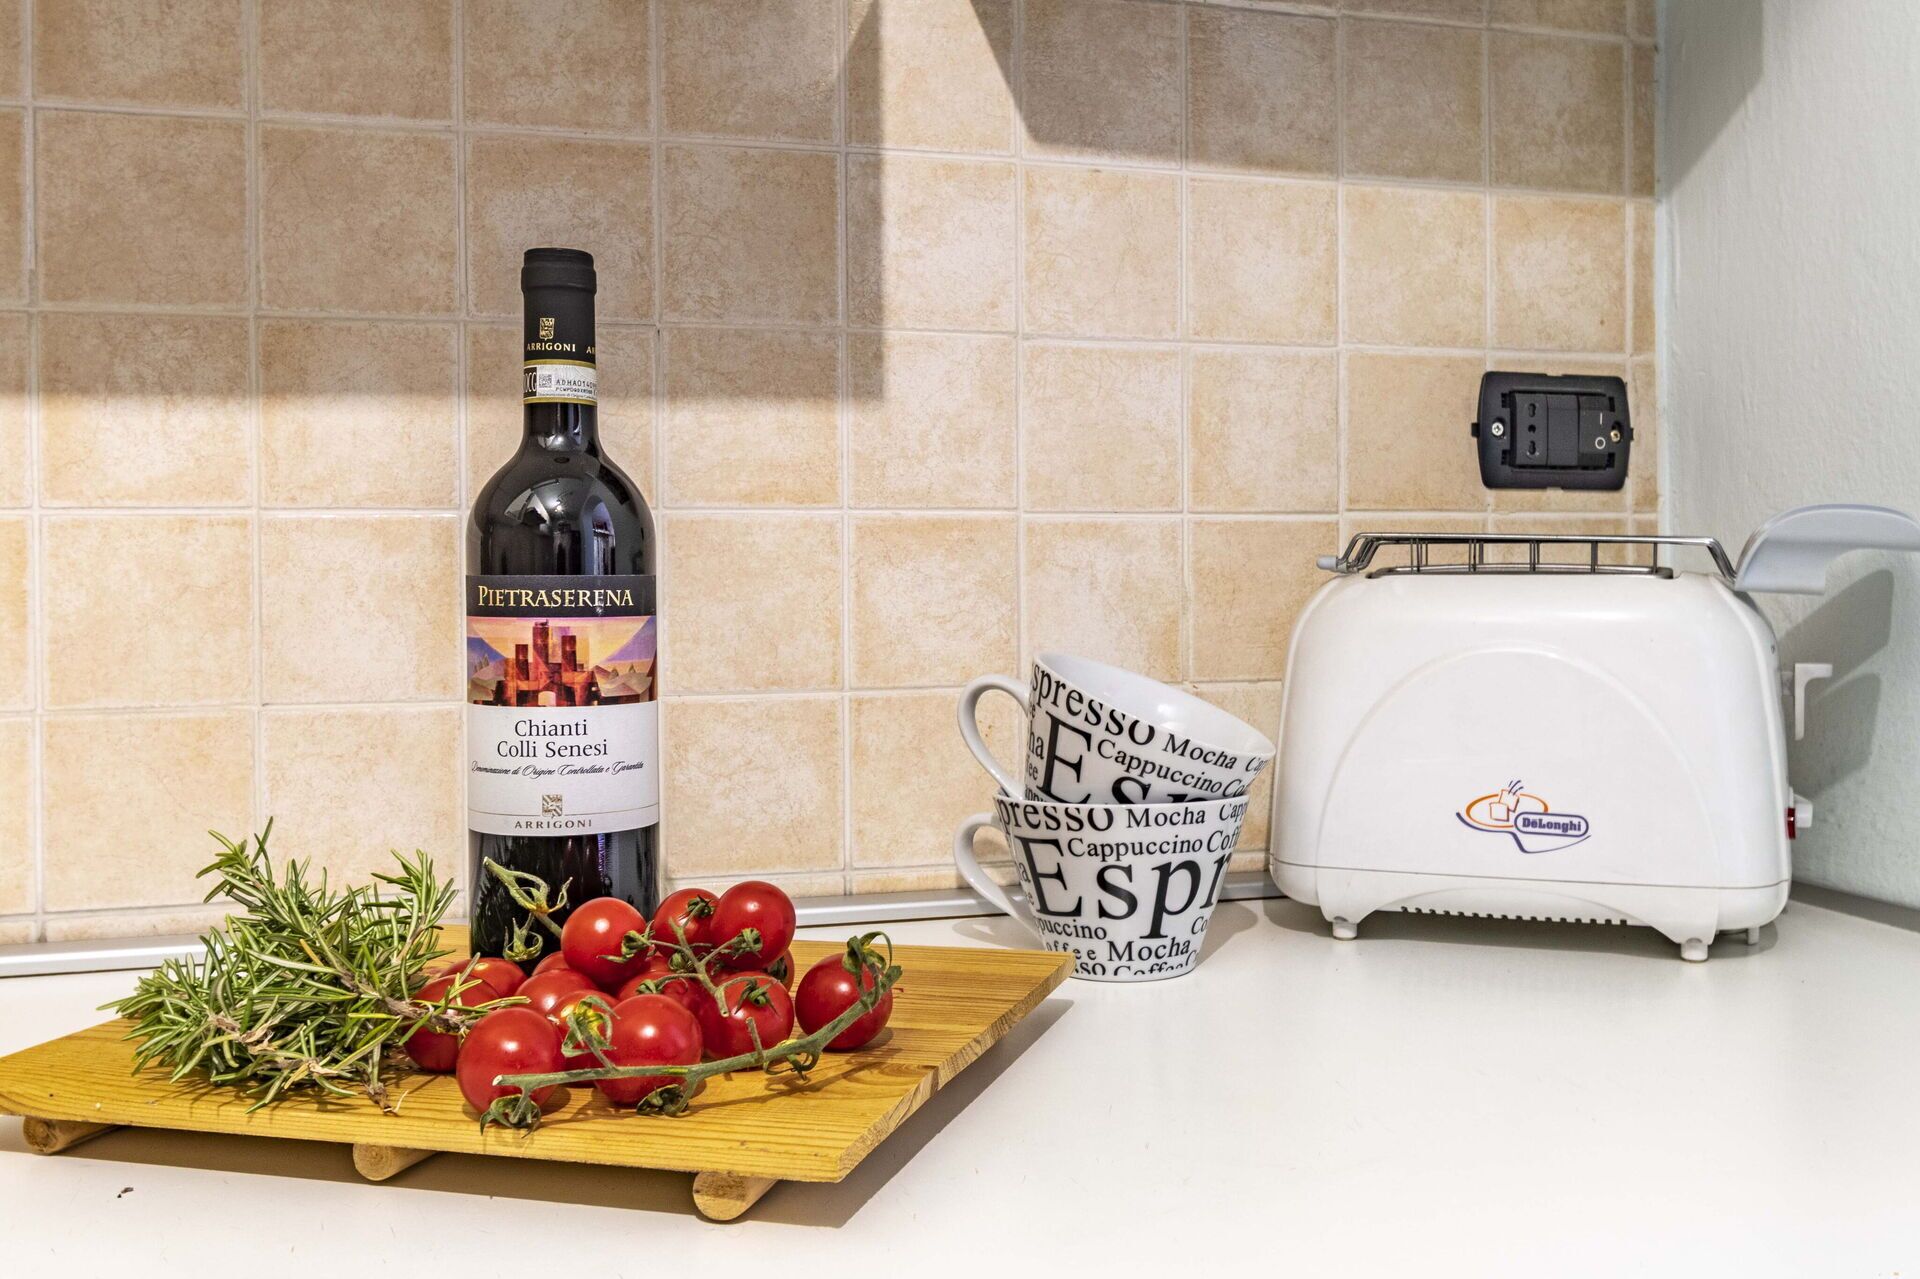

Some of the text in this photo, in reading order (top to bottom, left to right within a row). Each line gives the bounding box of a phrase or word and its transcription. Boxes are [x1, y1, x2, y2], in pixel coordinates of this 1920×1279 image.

[527, 342, 576, 352] ARRIGONI
[478, 585, 634, 608] PIETRASERENA
[514, 719, 588, 737] Chianti
[497, 739, 608, 758] Colli Senesi
[1162, 733, 1238, 770] Mocha
[511, 766, 521, 775] di
[522, 764, 556, 779] Origine
[557, 764, 604, 776] Controllata
[1096, 738, 1223, 794] Cappuccino
[514, 819, 592, 829] ARRIGONI
[1126, 806, 1206, 828] Mocha
[1067, 835, 1203, 863] Cappuccino
[1107, 936, 1192, 963] Mocha
